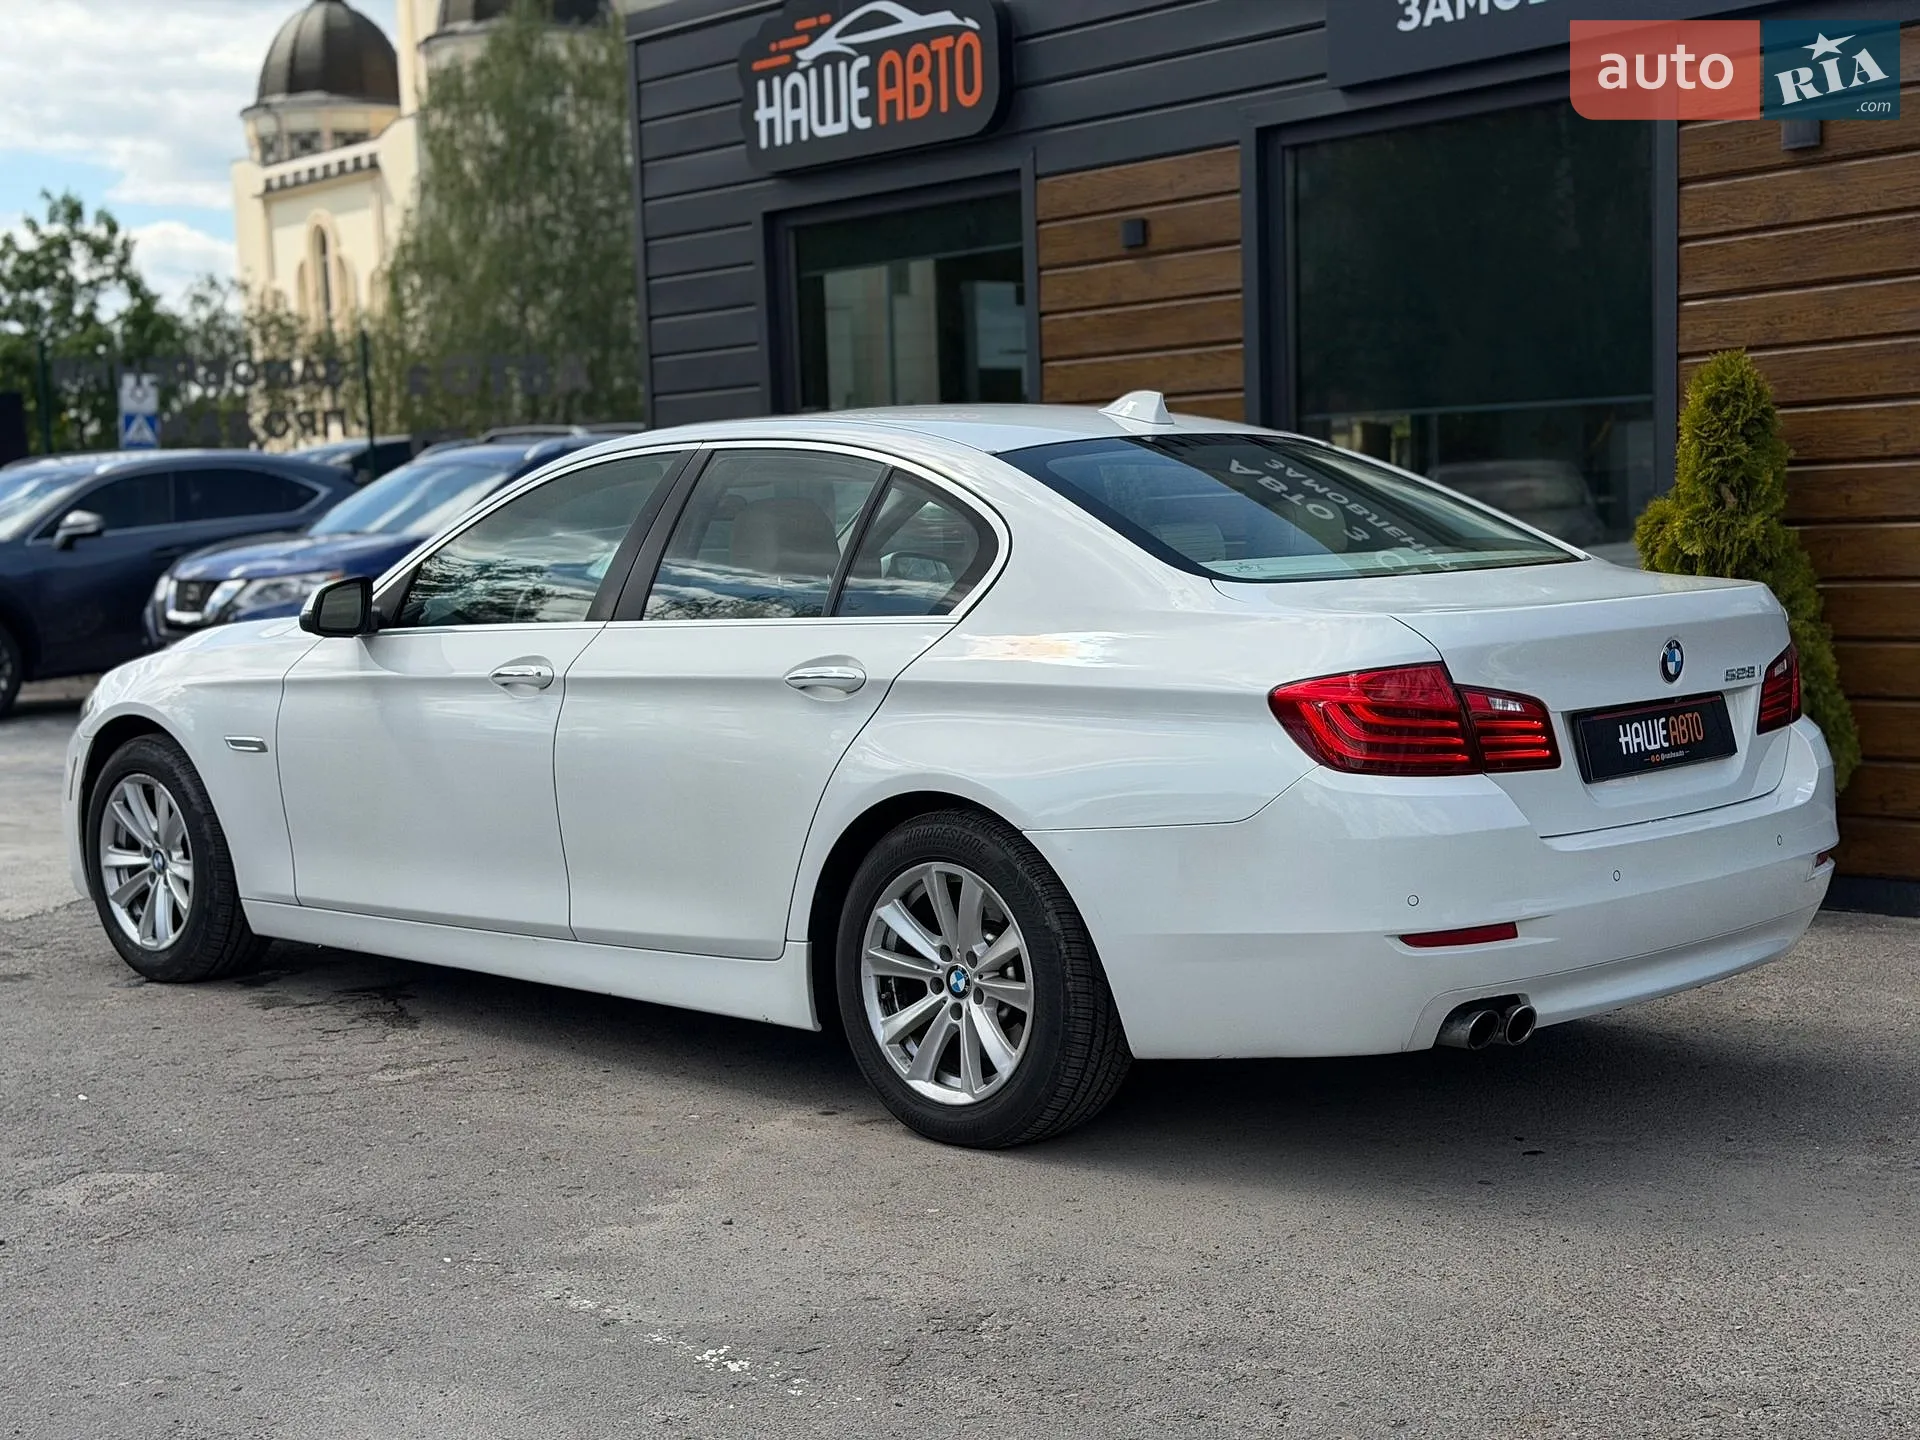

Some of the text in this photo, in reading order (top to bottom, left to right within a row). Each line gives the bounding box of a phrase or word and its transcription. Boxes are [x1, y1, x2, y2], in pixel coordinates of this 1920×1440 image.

[753, 31, 983, 150] НАШЕ АВТО
[1618, 711, 1704, 755] НАШЕ АВТО
